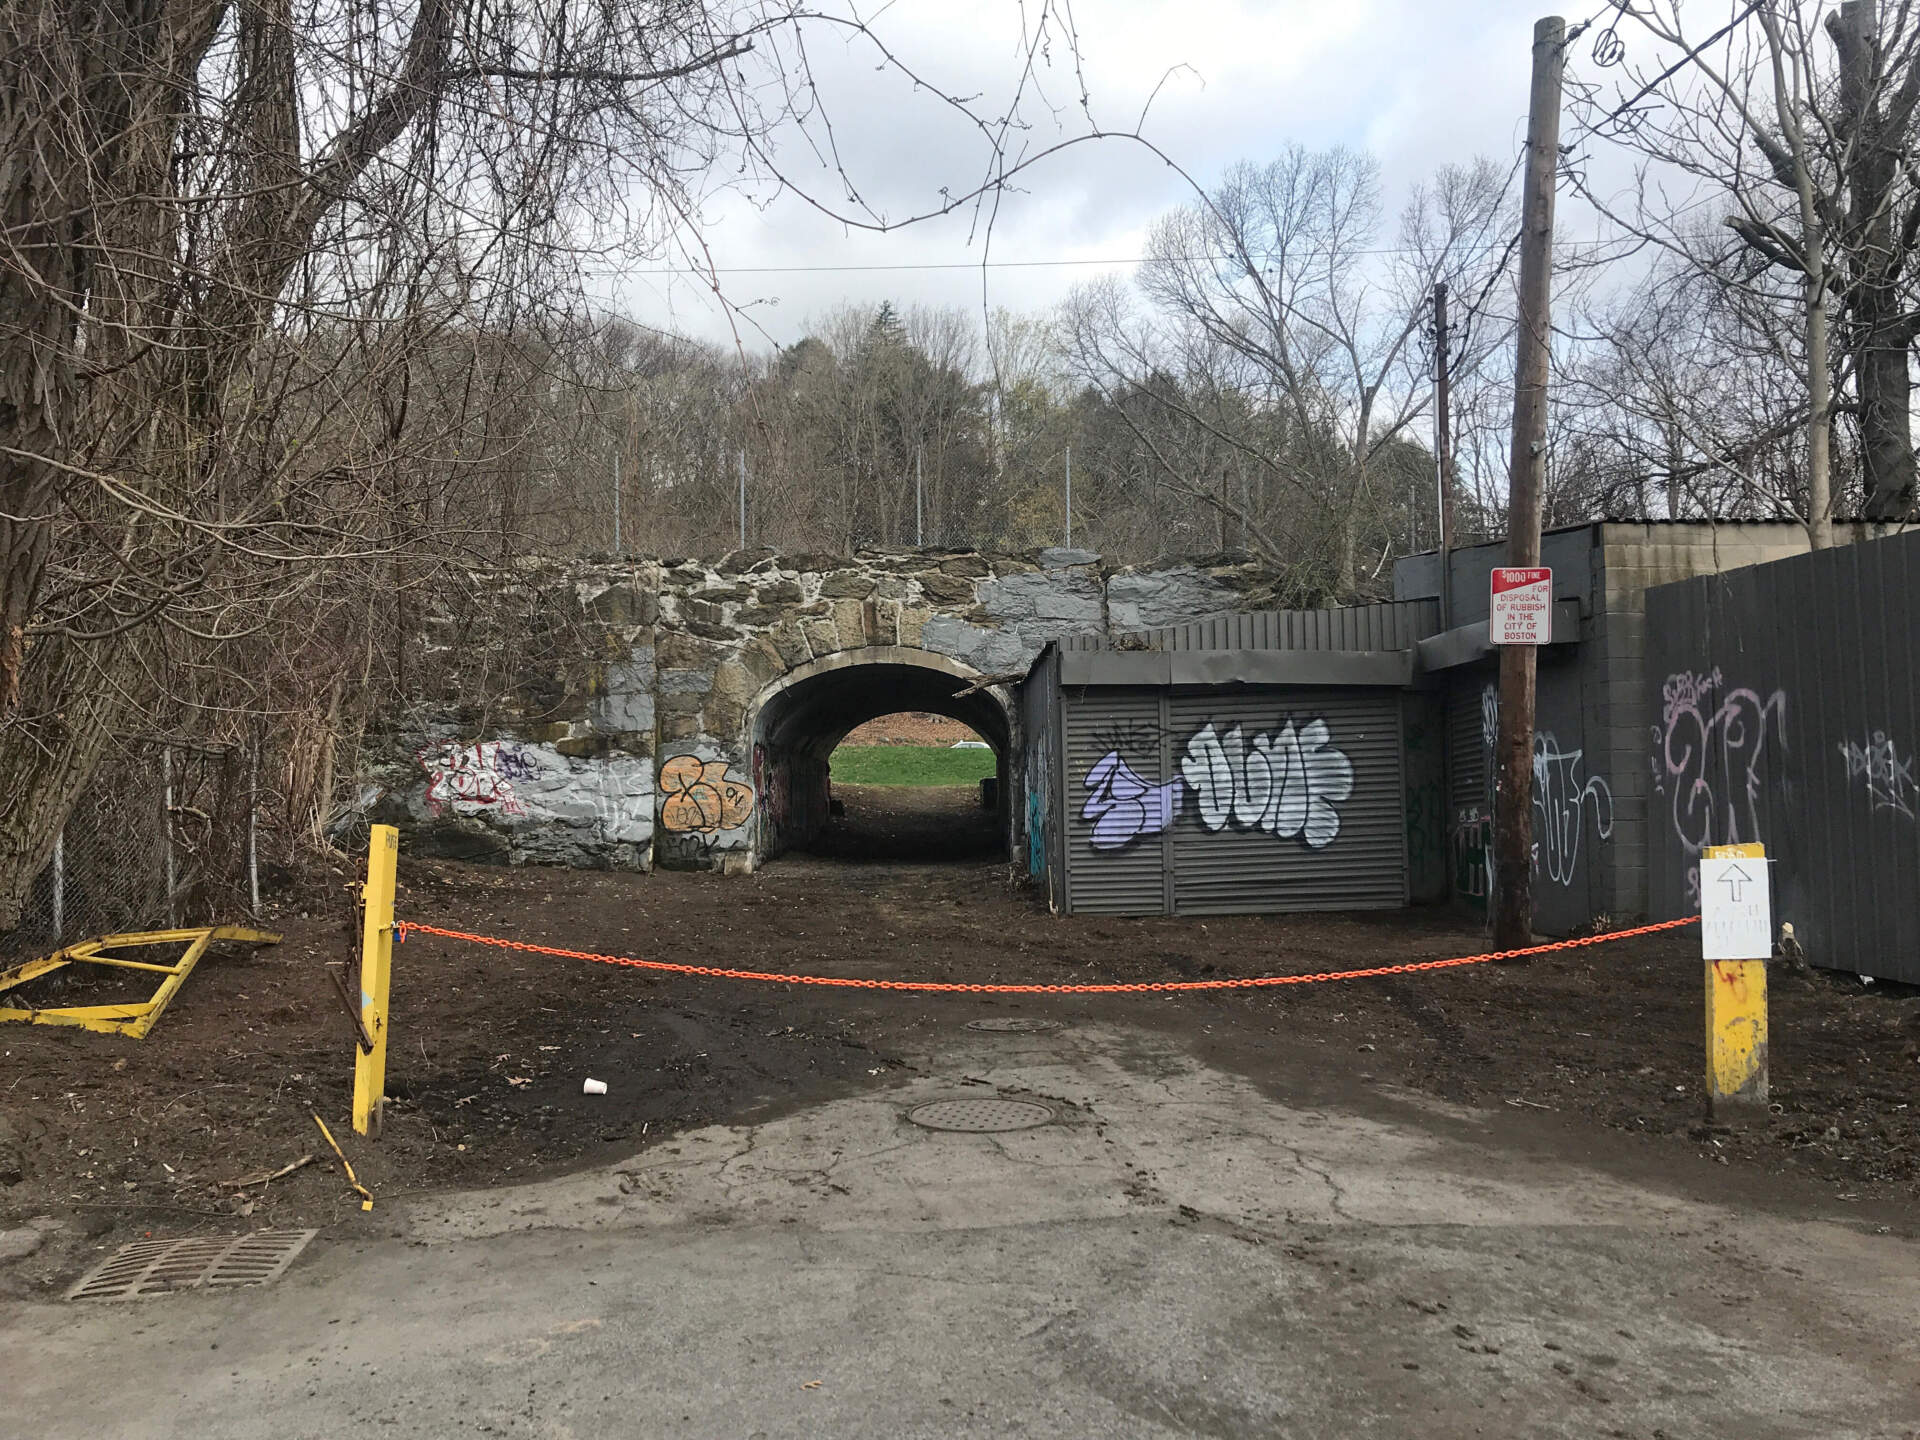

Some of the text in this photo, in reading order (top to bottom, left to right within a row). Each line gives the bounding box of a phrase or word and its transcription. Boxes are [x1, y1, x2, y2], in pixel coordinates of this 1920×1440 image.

[1532, 585, 1549, 593] FOR
[1500, 594, 1542, 602] DISPOSAL
[1510, 603, 1546, 611] RUBBISH
[1504, 622, 1537, 630] CITY OF
[1504, 632, 1537, 640] BOSTON
